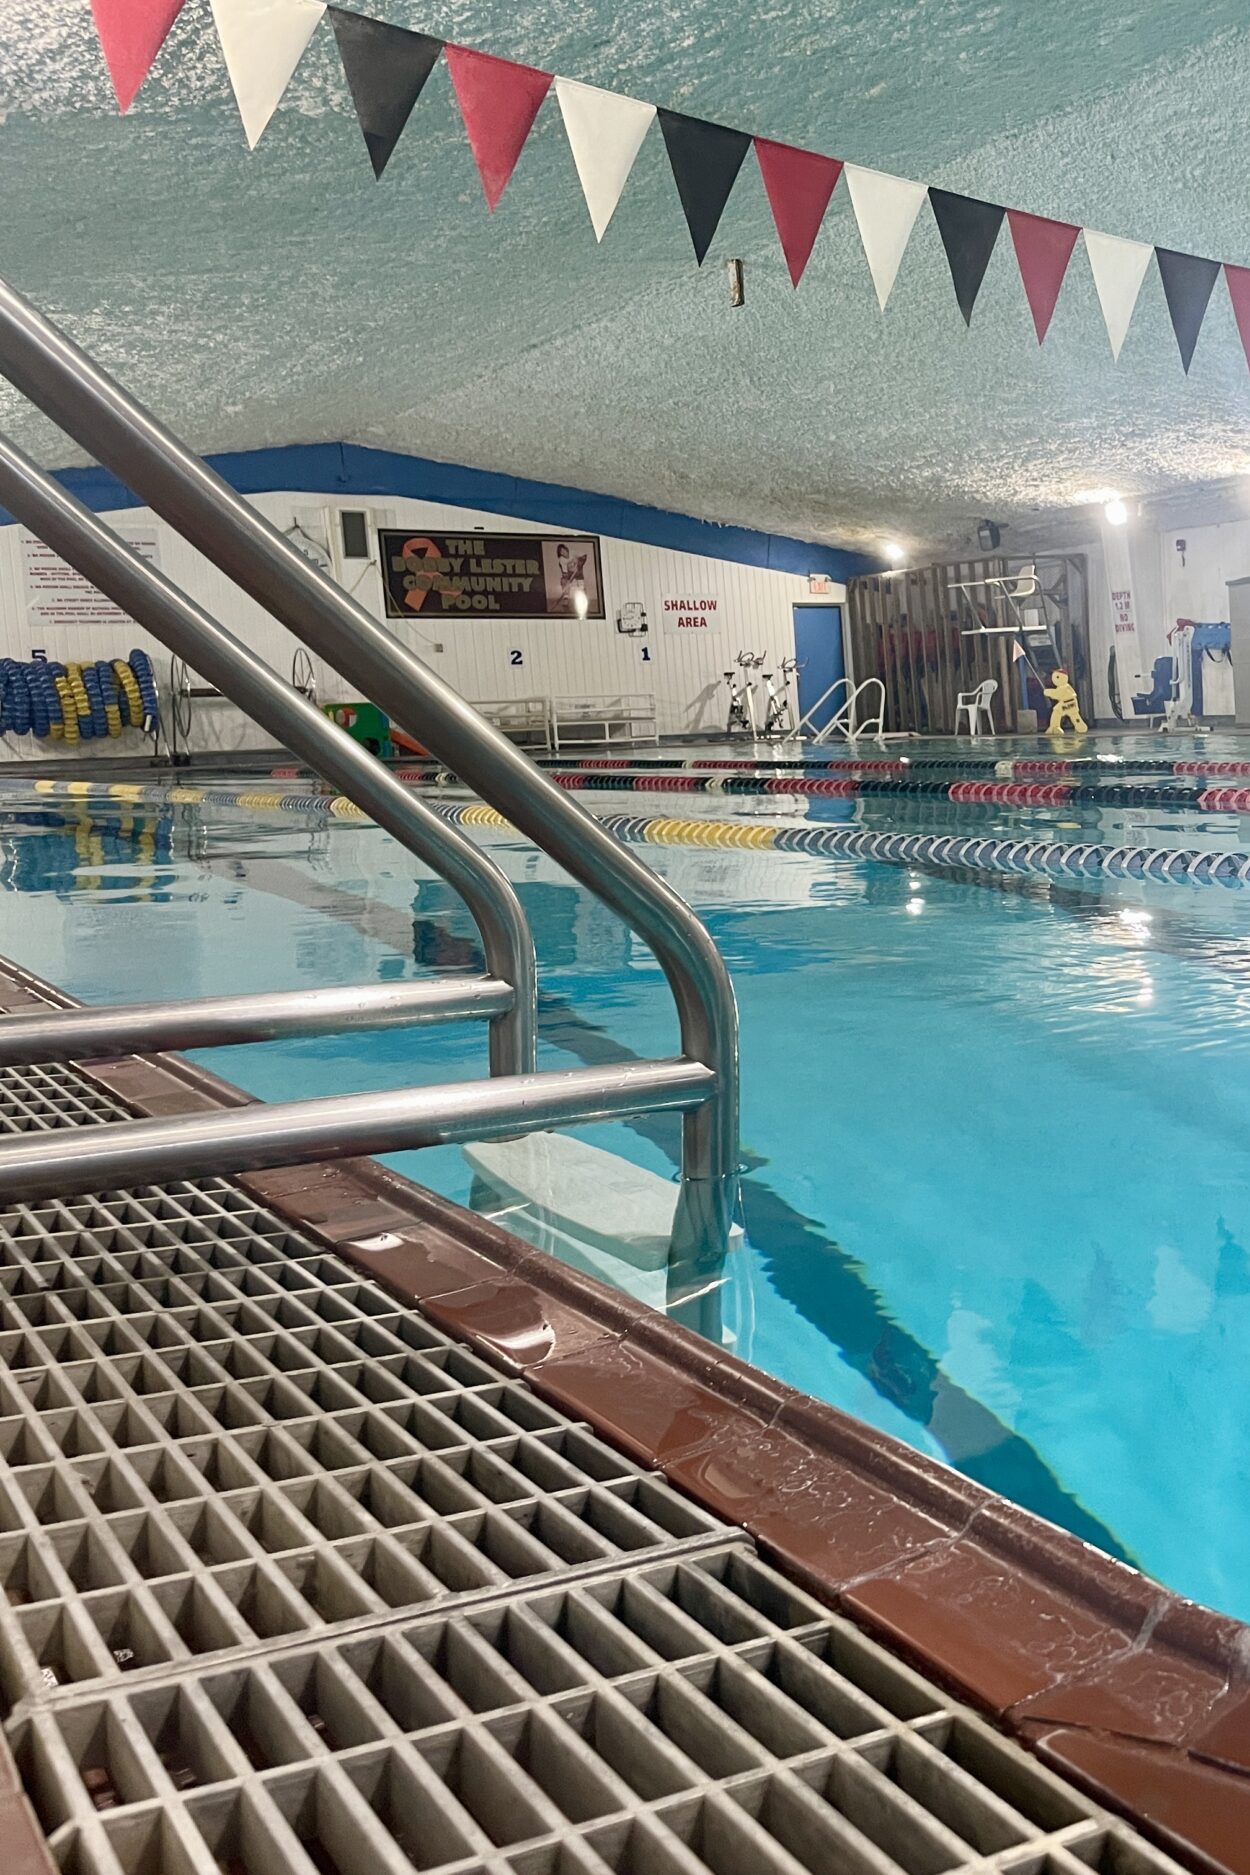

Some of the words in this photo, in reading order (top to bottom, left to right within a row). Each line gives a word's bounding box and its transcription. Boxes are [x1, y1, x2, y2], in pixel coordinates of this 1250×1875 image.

[445, 538, 485, 556] THE
[469, 557, 540, 576] LESTER
[402, 573, 534, 593] COMMUNITY
[441, 593, 501, 611] POOL
[664, 599, 718, 612] SHALLOW
[677, 616, 708, 629] AREA
[31, 649, 48, 664] 5
[510, 649, 524, 665] 2
[641, 647, 651, 661] 1
